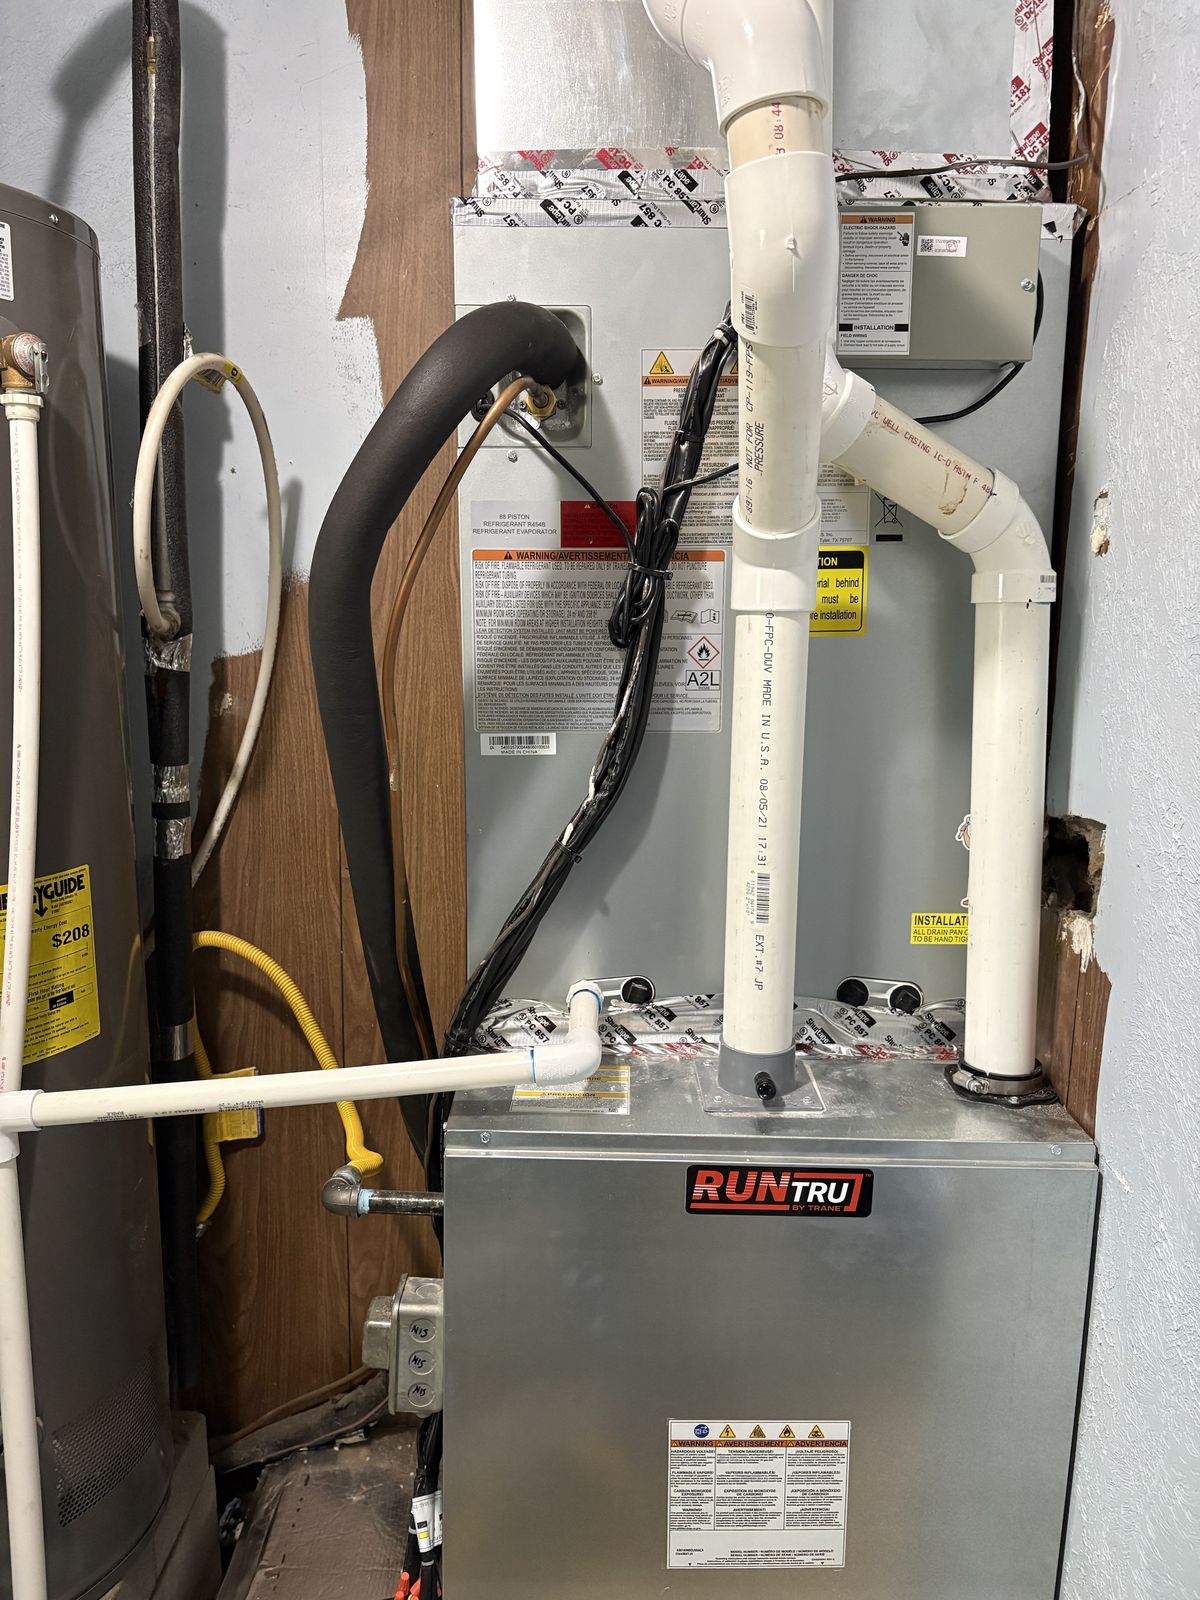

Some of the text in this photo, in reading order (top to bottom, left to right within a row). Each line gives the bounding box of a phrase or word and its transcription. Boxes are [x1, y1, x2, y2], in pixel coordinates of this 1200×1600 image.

[754, 421, 764, 472] PRESSURE
[882, 416, 901, 435] WELL
[904, 430, 932, 454] CASING
[818, 557, 838, 566] TION
[836, 578, 859, 588] behind
[822, 594, 858, 604] must be
[820, 610, 856, 620] installation
[686, 672, 719, 686] A2L
[762, 679, 772, 706] MADE
[762, 714, 770, 727] IN
[760, 733, 770, 770] U.S.A.
[758, 778, 768, 828] 08/05/21
[757, 838, 767, 867] 17:31
[52, 924, 90, 948] $208
[754, 977, 764, 991] JP
[526, 1019, 550, 1043] PC 857
[604, 1015, 632, 1042] Shurtape
[645, 1008, 669, 1032] PC 857
[845, 1015, 869, 1038] PC 857
[924, 1029, 935, 1040] PC
[692, 1170, 849, 1204] RUNTRU
